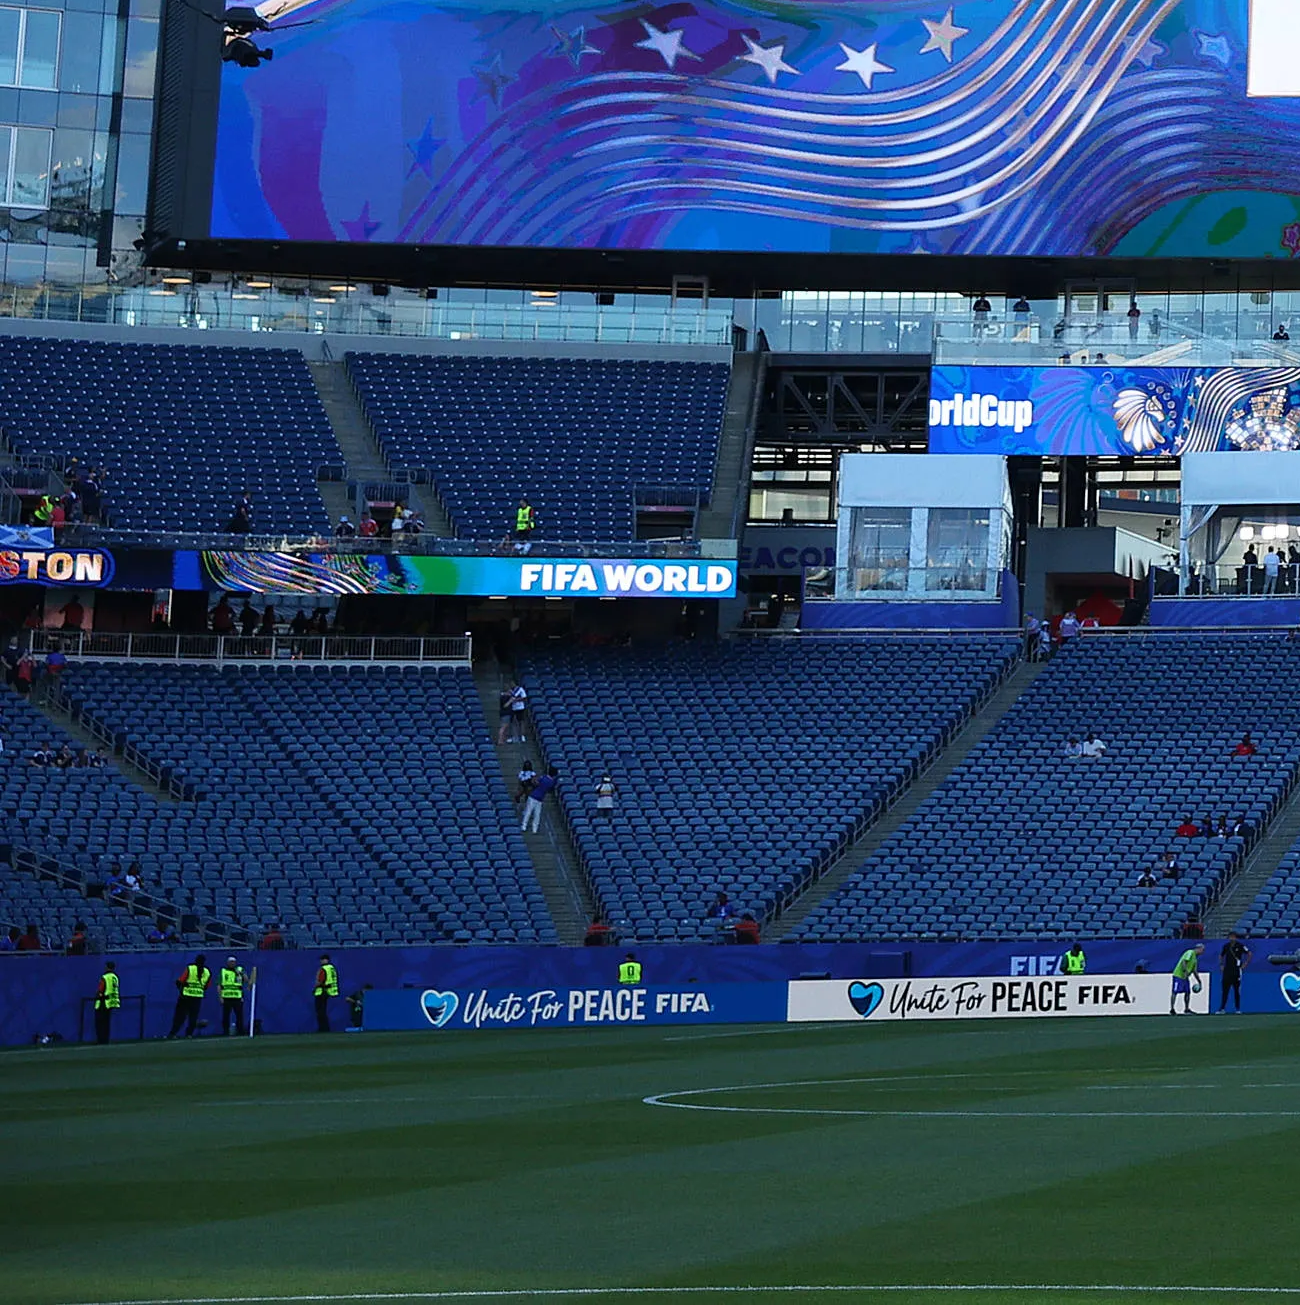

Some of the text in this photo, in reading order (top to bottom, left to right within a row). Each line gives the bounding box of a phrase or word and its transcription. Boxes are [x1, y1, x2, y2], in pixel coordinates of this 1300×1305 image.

[0, 551, 103, 581] STON
[520, 564, 733, 593] FIFA WORLD
[463, 988, 710, 1028] Unite For PEACE FIFA
[889, 981, 1131, 1018] Unite For PEACE FIFA
